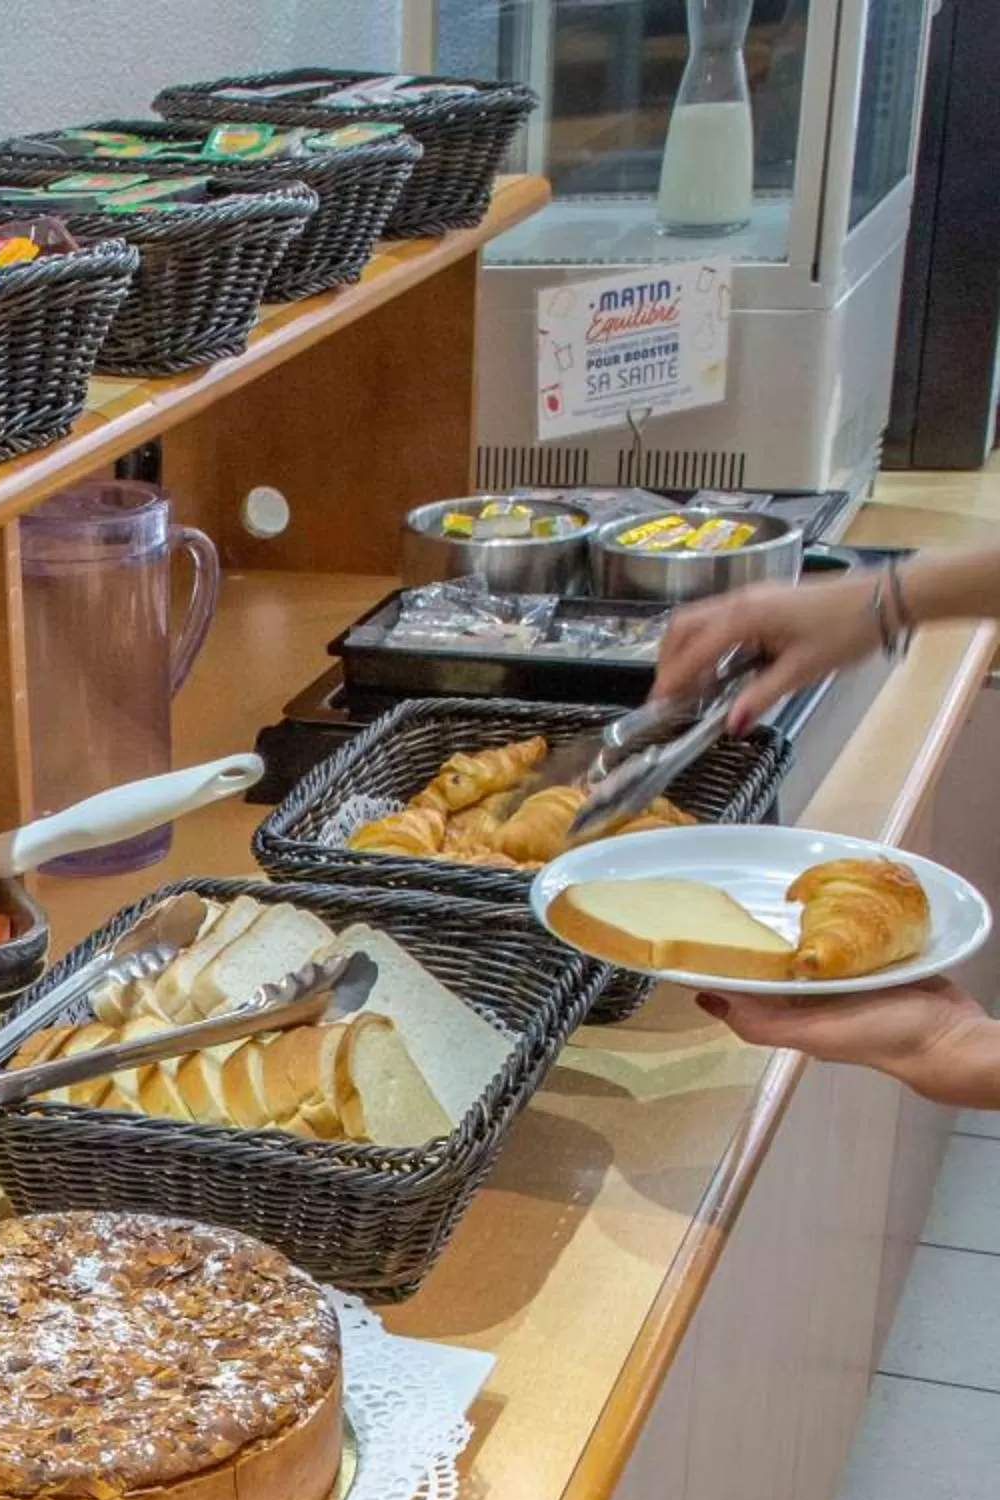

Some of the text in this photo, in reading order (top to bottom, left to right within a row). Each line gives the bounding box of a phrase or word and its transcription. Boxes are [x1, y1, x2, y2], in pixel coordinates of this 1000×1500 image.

[600, 280, 671, 312] MATIN
[586, 354, 621, 373] POUR
[624, 341, 679, 363] BOOSTER
[586, 357, 678, 396] SA SANTÉ
